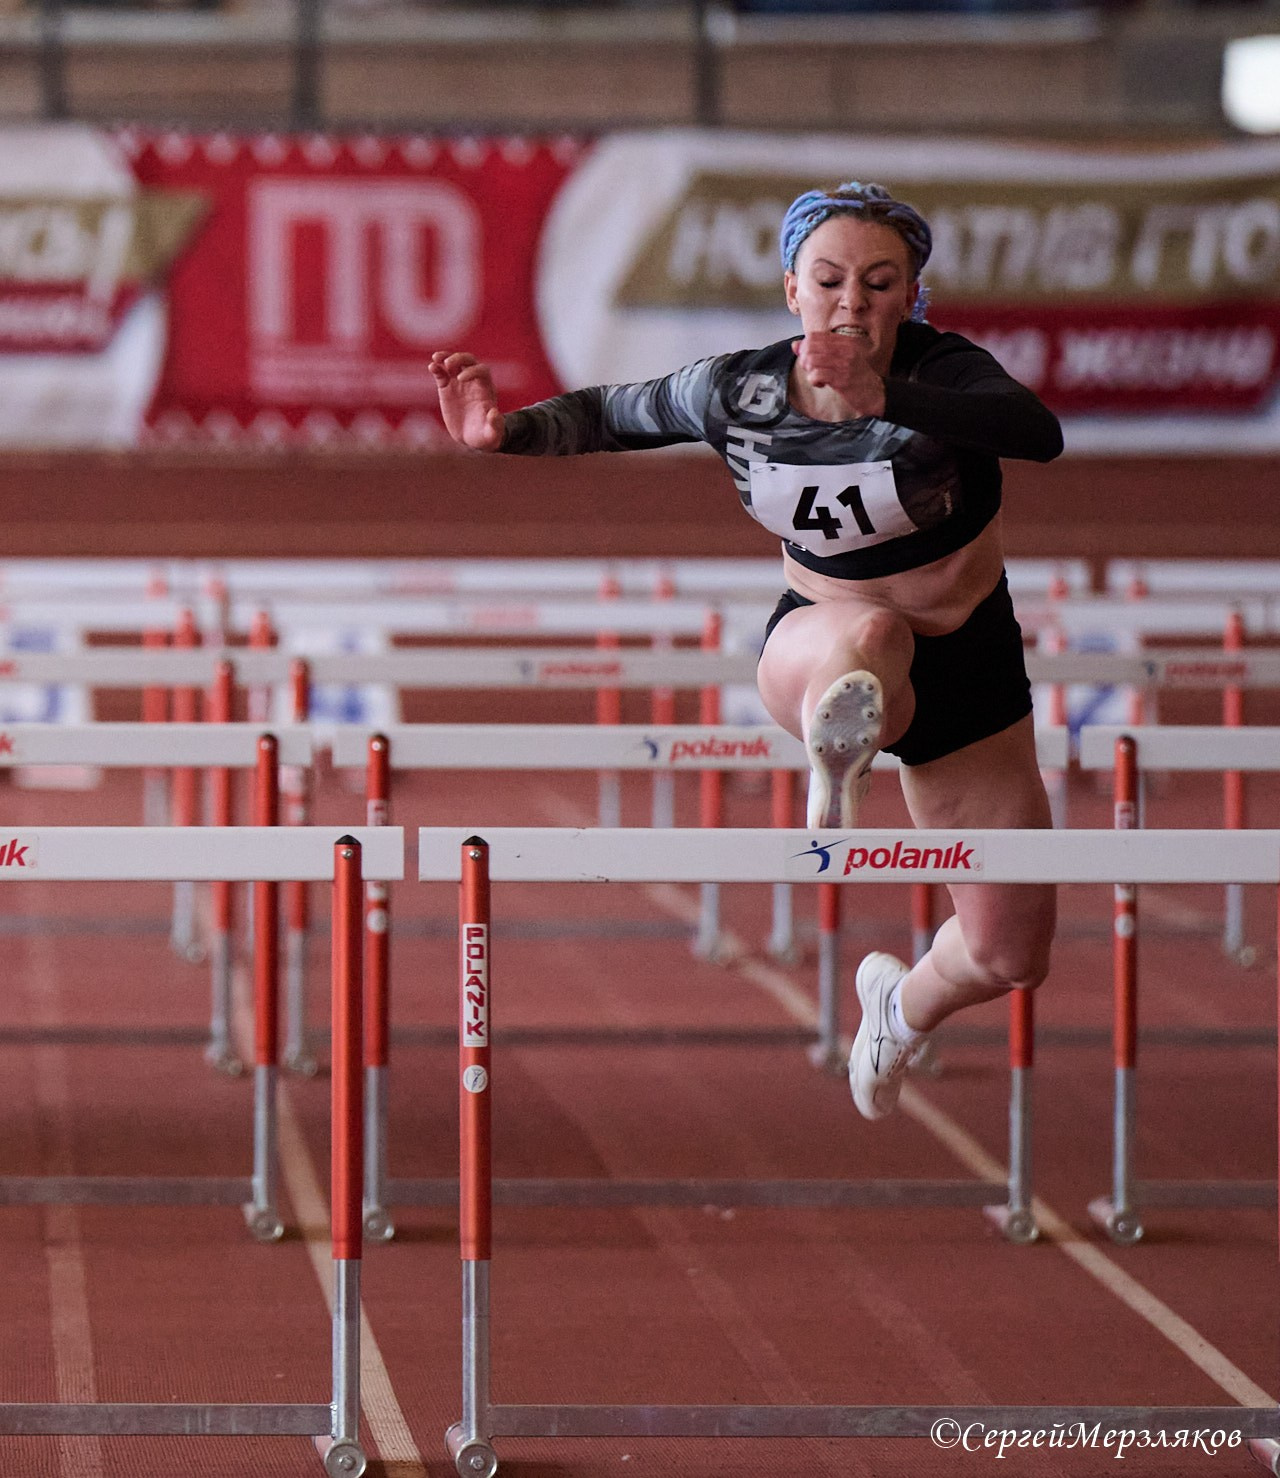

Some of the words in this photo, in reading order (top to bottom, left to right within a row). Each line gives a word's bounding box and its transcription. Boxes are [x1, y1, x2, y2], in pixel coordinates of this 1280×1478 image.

[792, 485, 876, 540] 41
[669, 735, 773, 762] polanik
[843, 840, 976, 876] polanik
[465, 926, 486, 1038] POLANIK
